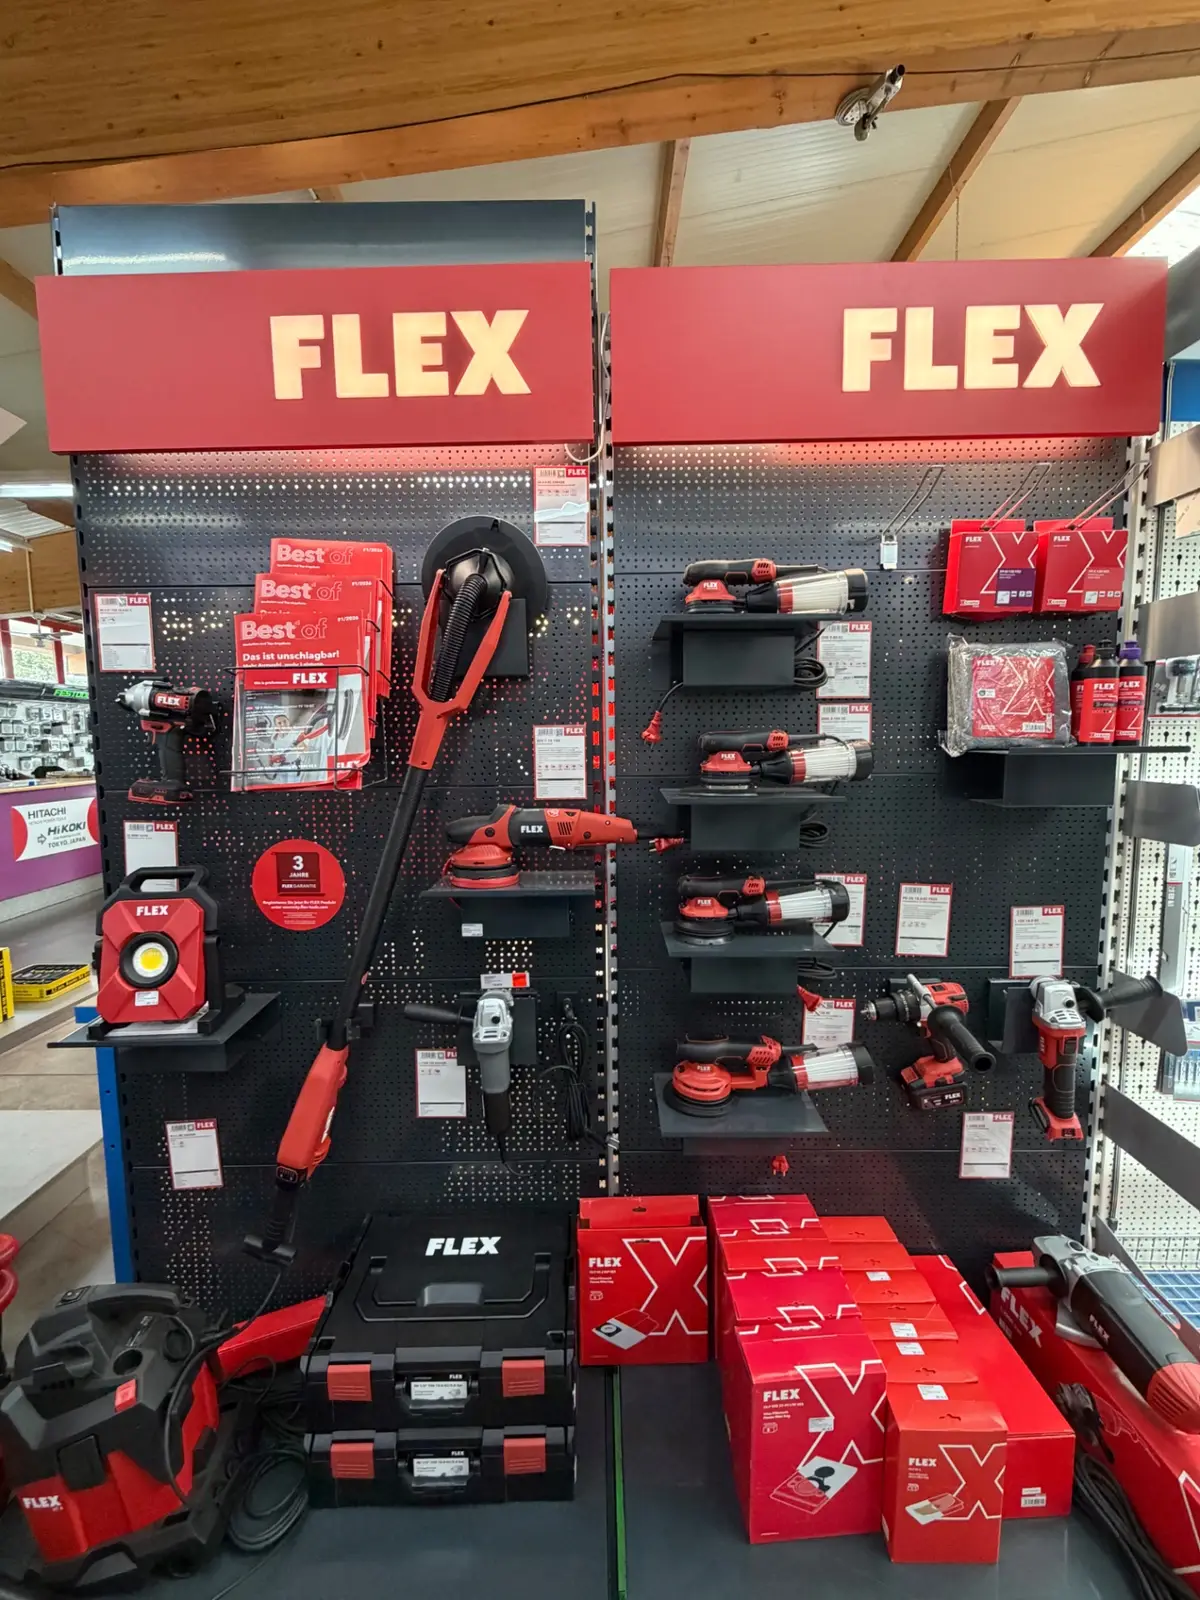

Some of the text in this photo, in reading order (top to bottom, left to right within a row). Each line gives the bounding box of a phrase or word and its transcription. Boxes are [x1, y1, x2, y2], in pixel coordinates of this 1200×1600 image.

[842, 302, 1105, 393] FLEX
[269, 309, 531, 400] FLEX
[568, 468, 586, 476] FLEX
[277, 544, 353, 565] Best of
[261, 579, 342, 600] Best of
[241, 618, 328, 640] Best of
[243, 650, 340, 661] Das ist unschlagbar!
[292, 672, 328, 684] FLEX
[157, 695, 181, 706] FLEX
[28, 806, 67, 819] HITACHI
[521, 825, 543, 833] FLEX
[70, 836, 86, 844] JAPAN
[292, 855, 304, 870] 3
[136, 905, 169, 916] FLEX
[196, 1121, 215, 1129] FLEX
[425, 1236, 501, 1256] FLEX
[588, 1257, 622, 1268] FLEX
[1001, 1286, 1042, 1348] FLEX
[1089, 1313, 1110, 1345] FLEX
[763, 1388, 800, 1402] FLEX
[908, 1457, 937, 1467] FLEX
[23, 1495, 62, 1509] FLEX
